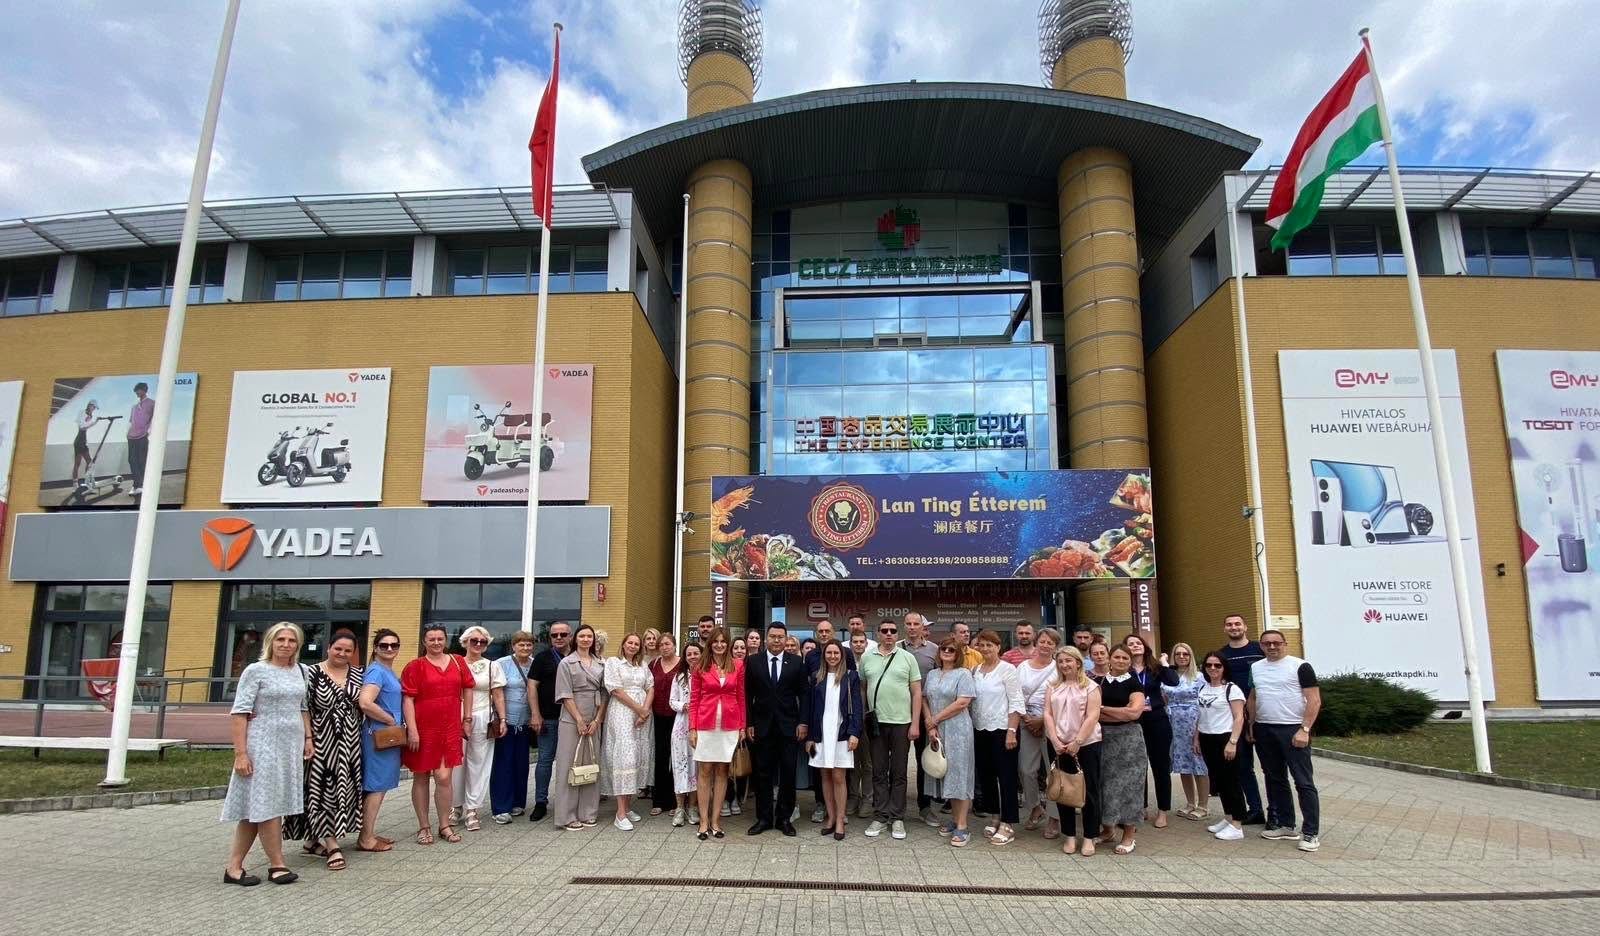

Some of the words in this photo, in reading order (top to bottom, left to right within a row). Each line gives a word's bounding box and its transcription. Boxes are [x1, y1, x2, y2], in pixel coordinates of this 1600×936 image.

[261, 393, 319, 404] GLOBAL
[325, 392, 357, 403] NO.1
[1341, 409, 1406, 419] HIVATALOS
[1310, 423, 1362, 433] HUAWEI
[1522, 420, 1574, 430] TOSOT
[795, 438, 829, 452] THE
[838, 436, 944, 452] EXPERIENCE
[952, 434, 1026, 450] CENTER
[490, 487, 529, 495] yadeashop.h
[882, 499, 915, 513] Lan
[921, 497, 962, 517] Ting
[969, 490, 1046, 512] Étterem
[933, 520, 994, 534] 澜庭餐厅
[255, 526, 384, 558] YADEA
[1352, 581, 1396, 590] HUAWEI
[1400, 581, 1432, 590] STORE
[715, 586, 723, 628] OUTLE
[877, 607, 910, 617] SHOP
[1139, 583, 1151, 632] OUTLET
[1384, 613, 1428, 621] HUAWEI
